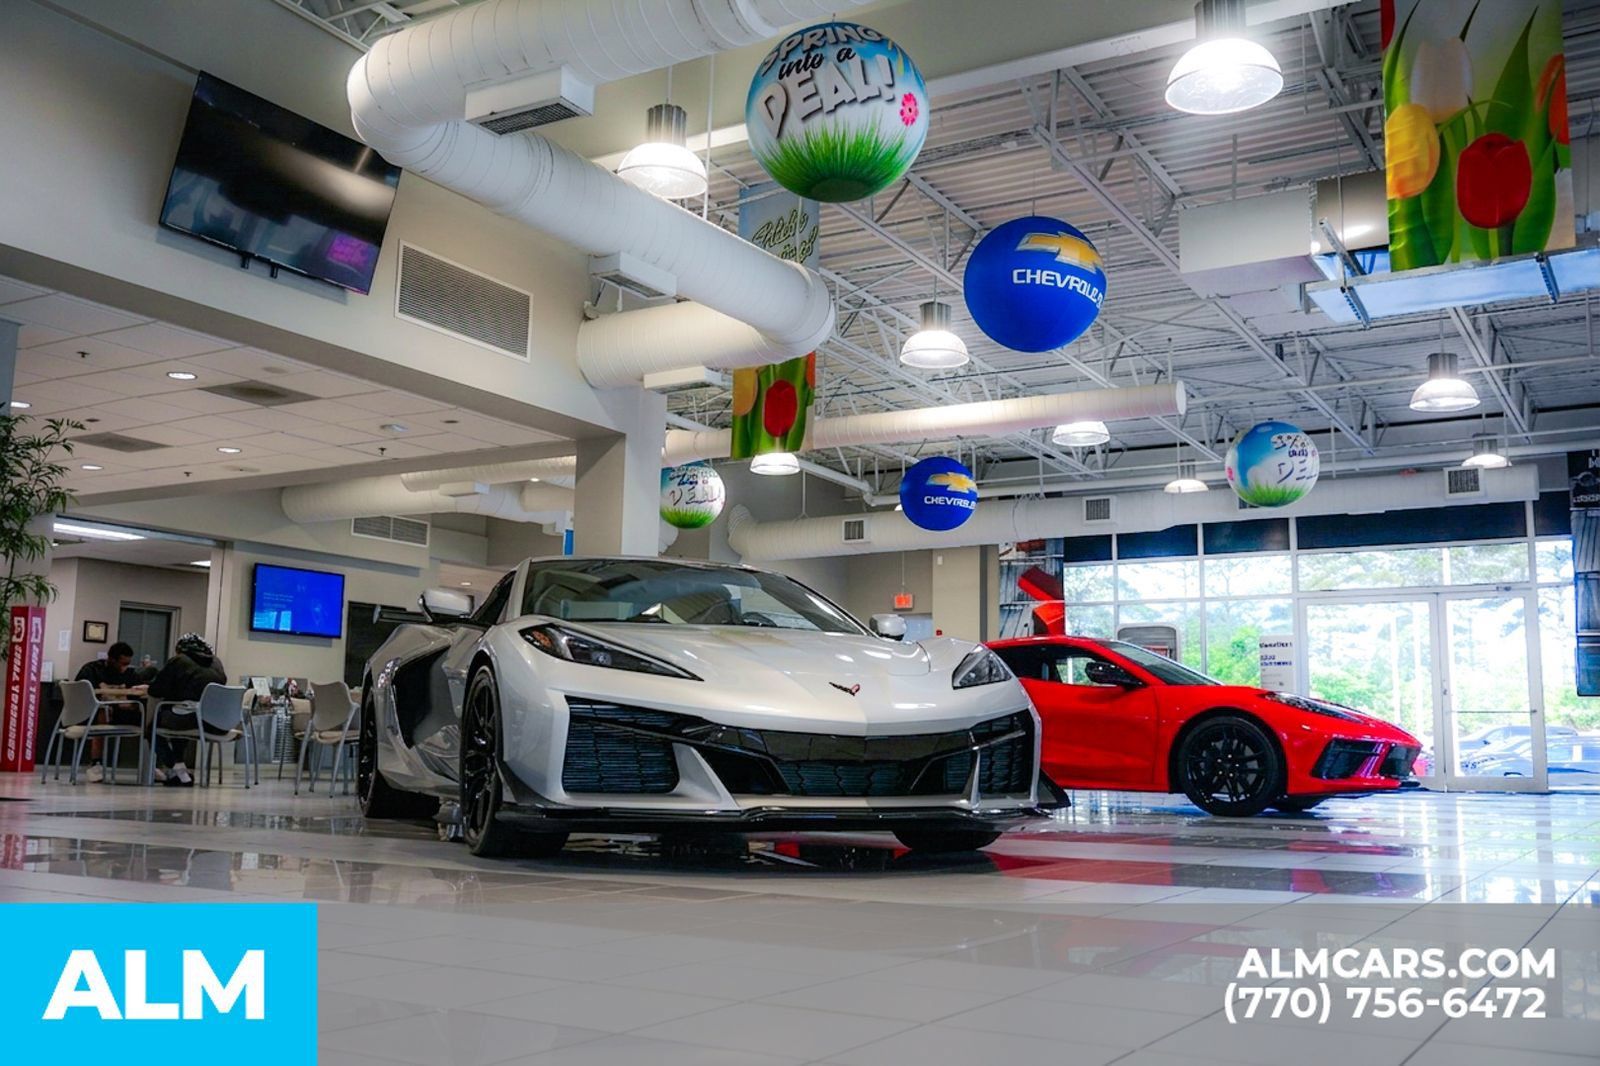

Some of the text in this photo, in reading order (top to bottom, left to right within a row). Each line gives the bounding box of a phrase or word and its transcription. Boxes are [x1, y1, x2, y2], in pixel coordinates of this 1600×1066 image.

[762, 26, 883, 77] SPRING
[778, 47, 856, 80] into a
[757, 54, 895, 139] DEAL!
